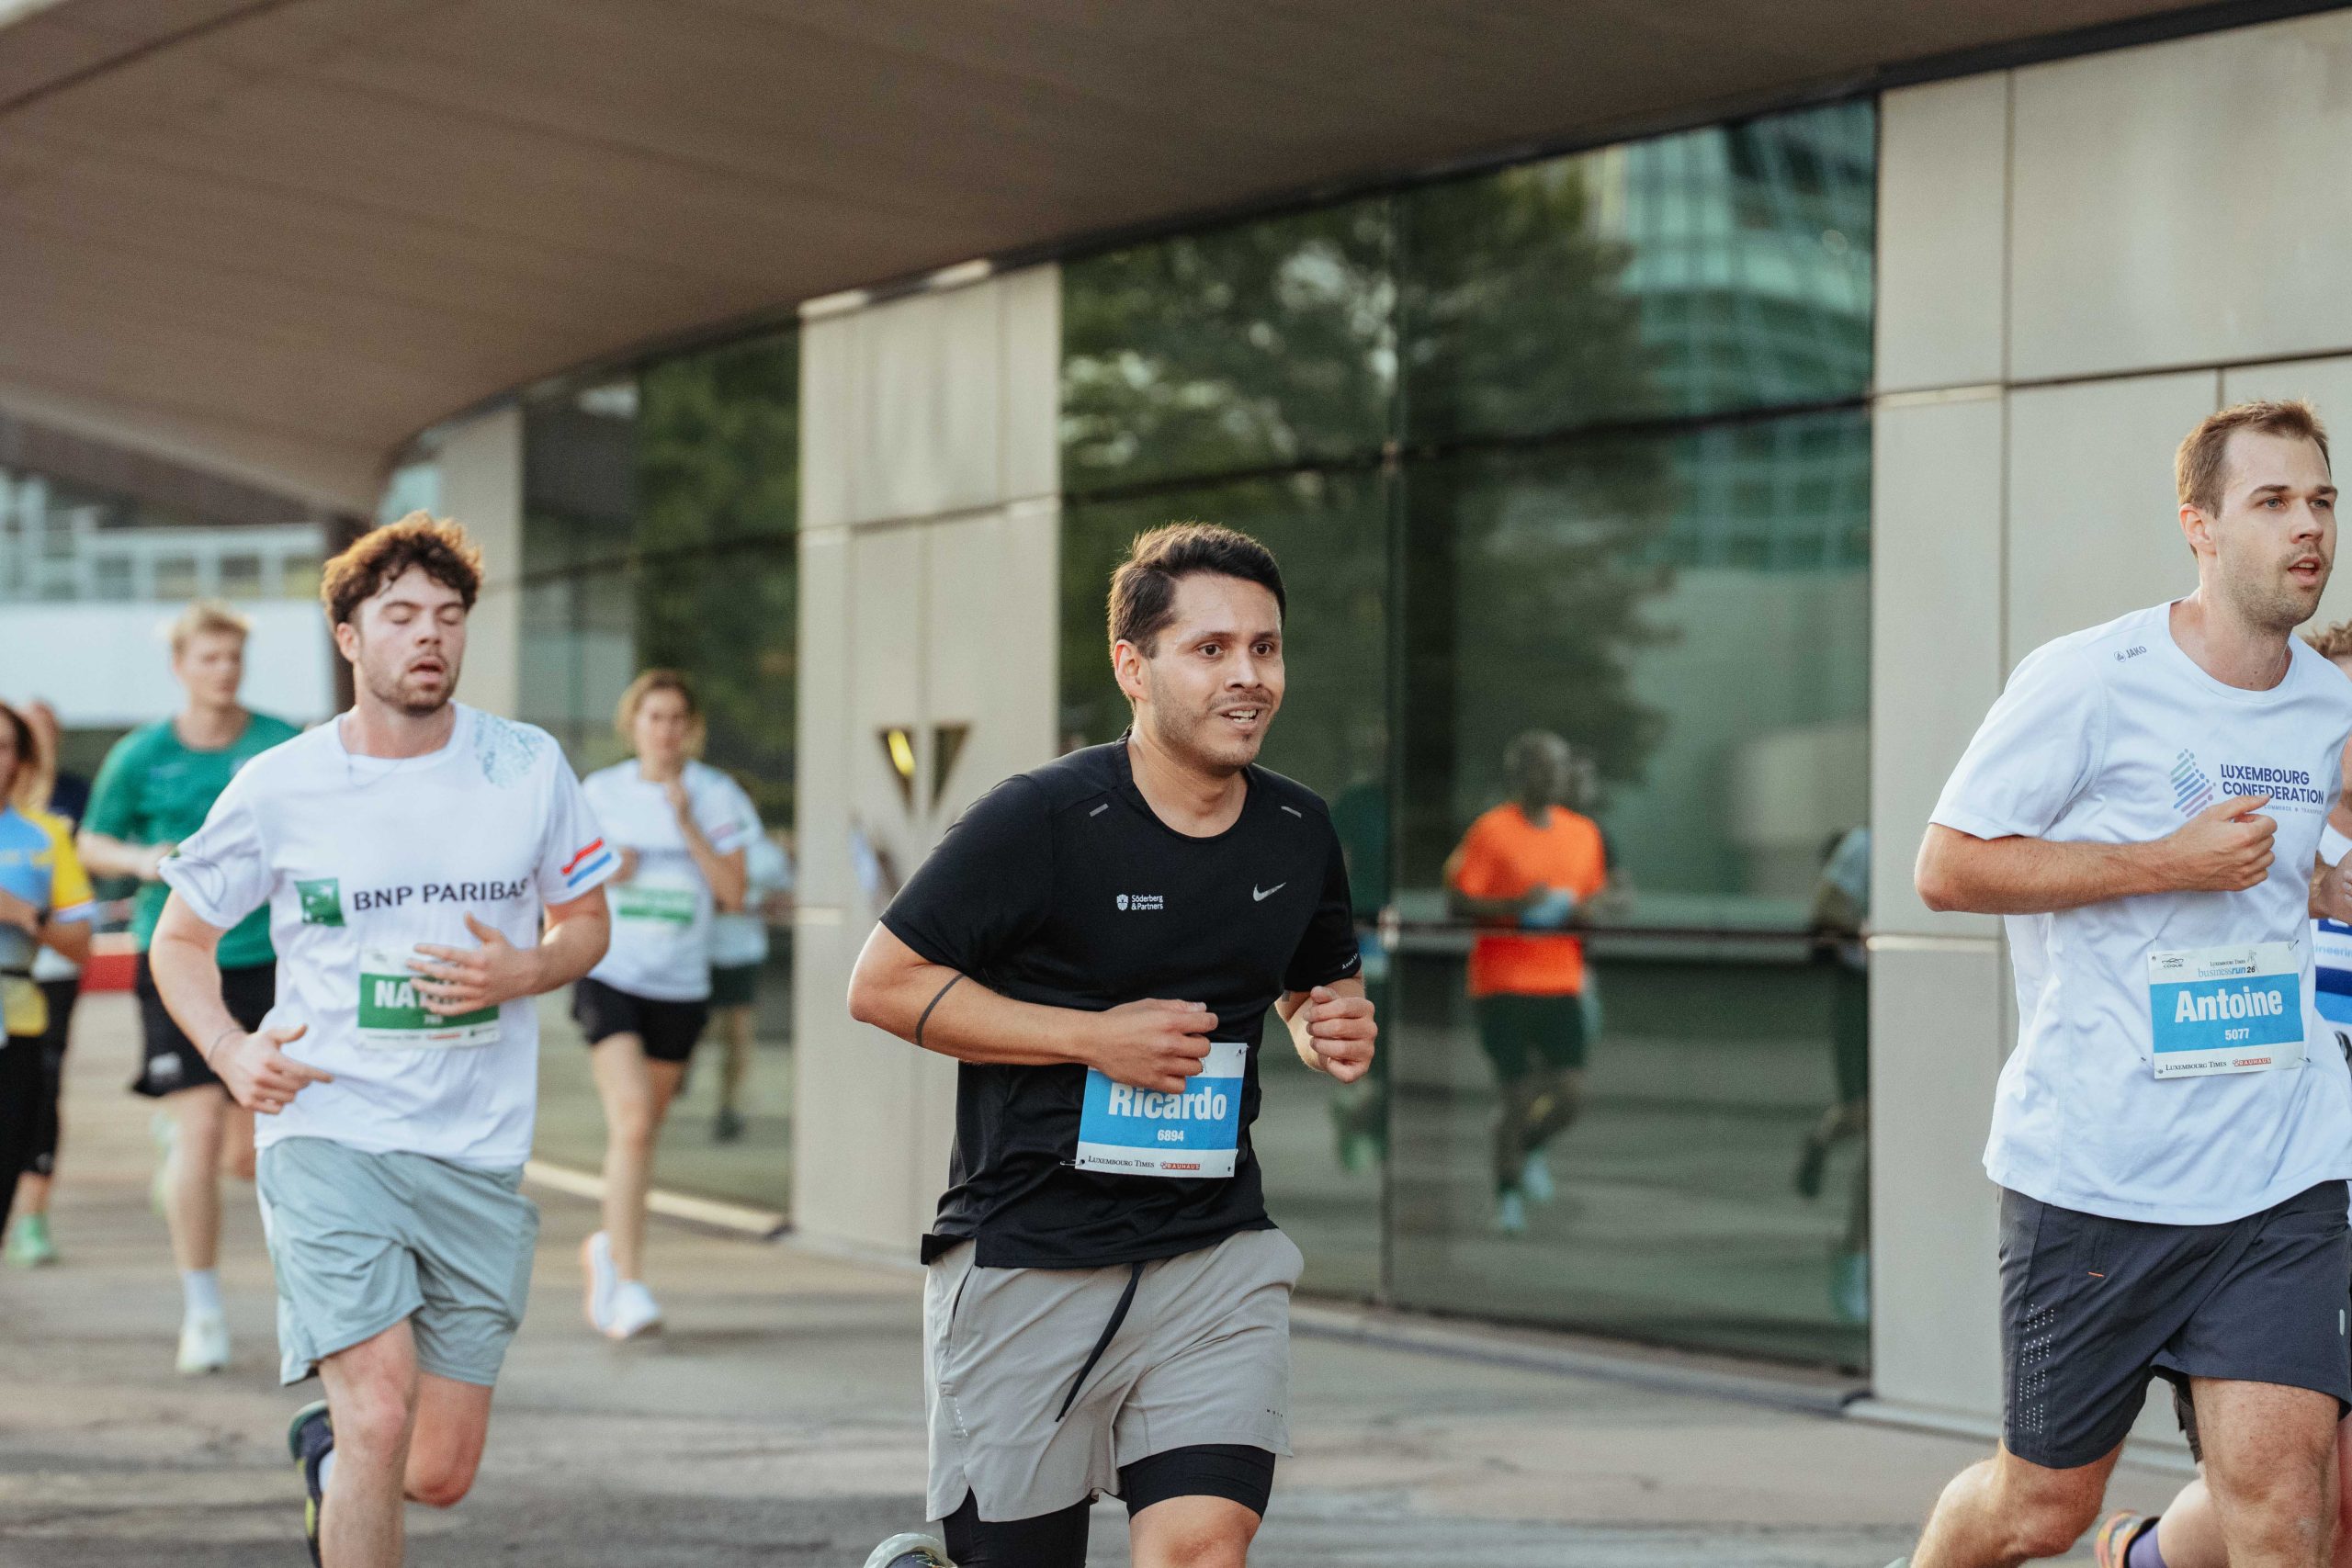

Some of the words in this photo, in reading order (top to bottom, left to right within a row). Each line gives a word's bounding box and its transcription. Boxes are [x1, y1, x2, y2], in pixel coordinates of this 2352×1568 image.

[2126, 646, 2147, 659] JAKO
[2221, 763, 2310, 785] LUXEMBOURG
[2222, 781, 2324, 805] CONFEDERATION
[354, 886, 413, 911] BNP
[423, 877, 528, 903] PARIBAS
[1131, 894, 1164, 903] Söderberg
[2246, 965, 2256, 974] 26
[2175, 986, 2283, 1022] Antoine
[2224, 1028, 2250, 1041] 5077
[1108, 1082, 1227, 1121] Ricardo
[1157, 1129, 1184, 1142] 6894
